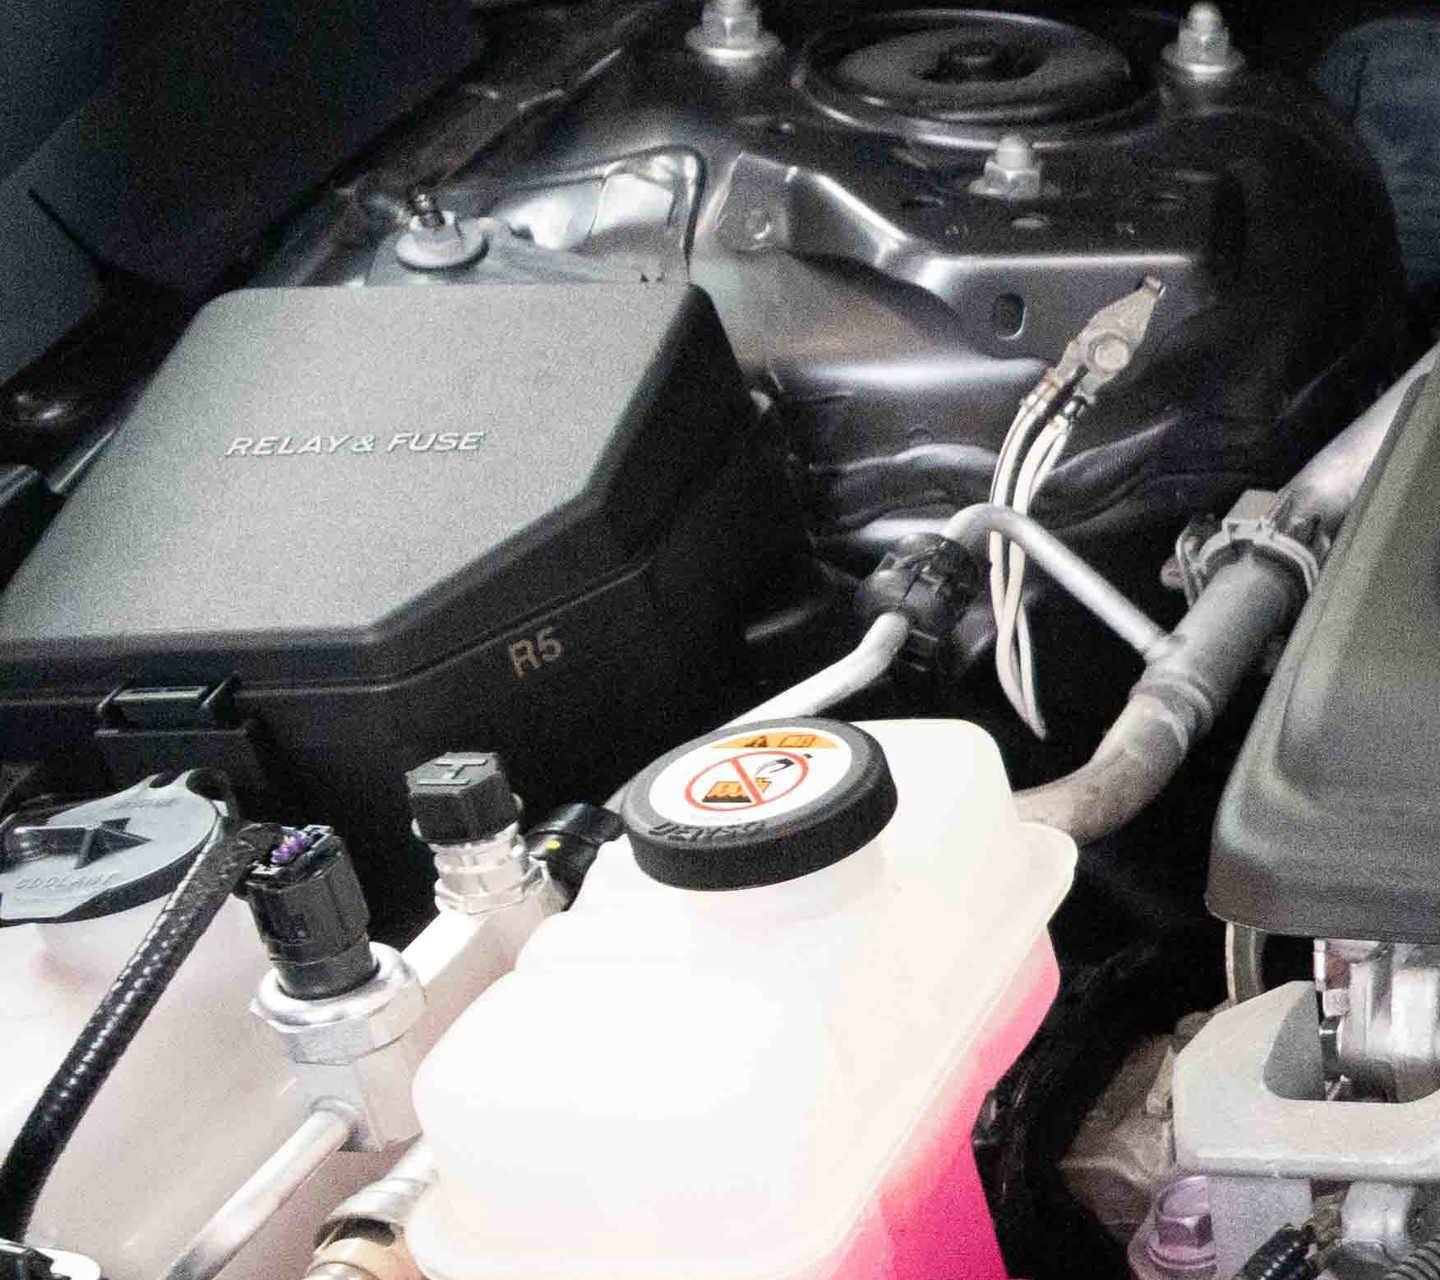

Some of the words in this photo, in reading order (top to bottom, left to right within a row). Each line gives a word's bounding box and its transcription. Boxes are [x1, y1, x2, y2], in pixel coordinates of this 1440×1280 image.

[224, 434, 350, 456] RELAY
[350, 434, 376, 453] &
[386, 431, 487, 453] FUSE
